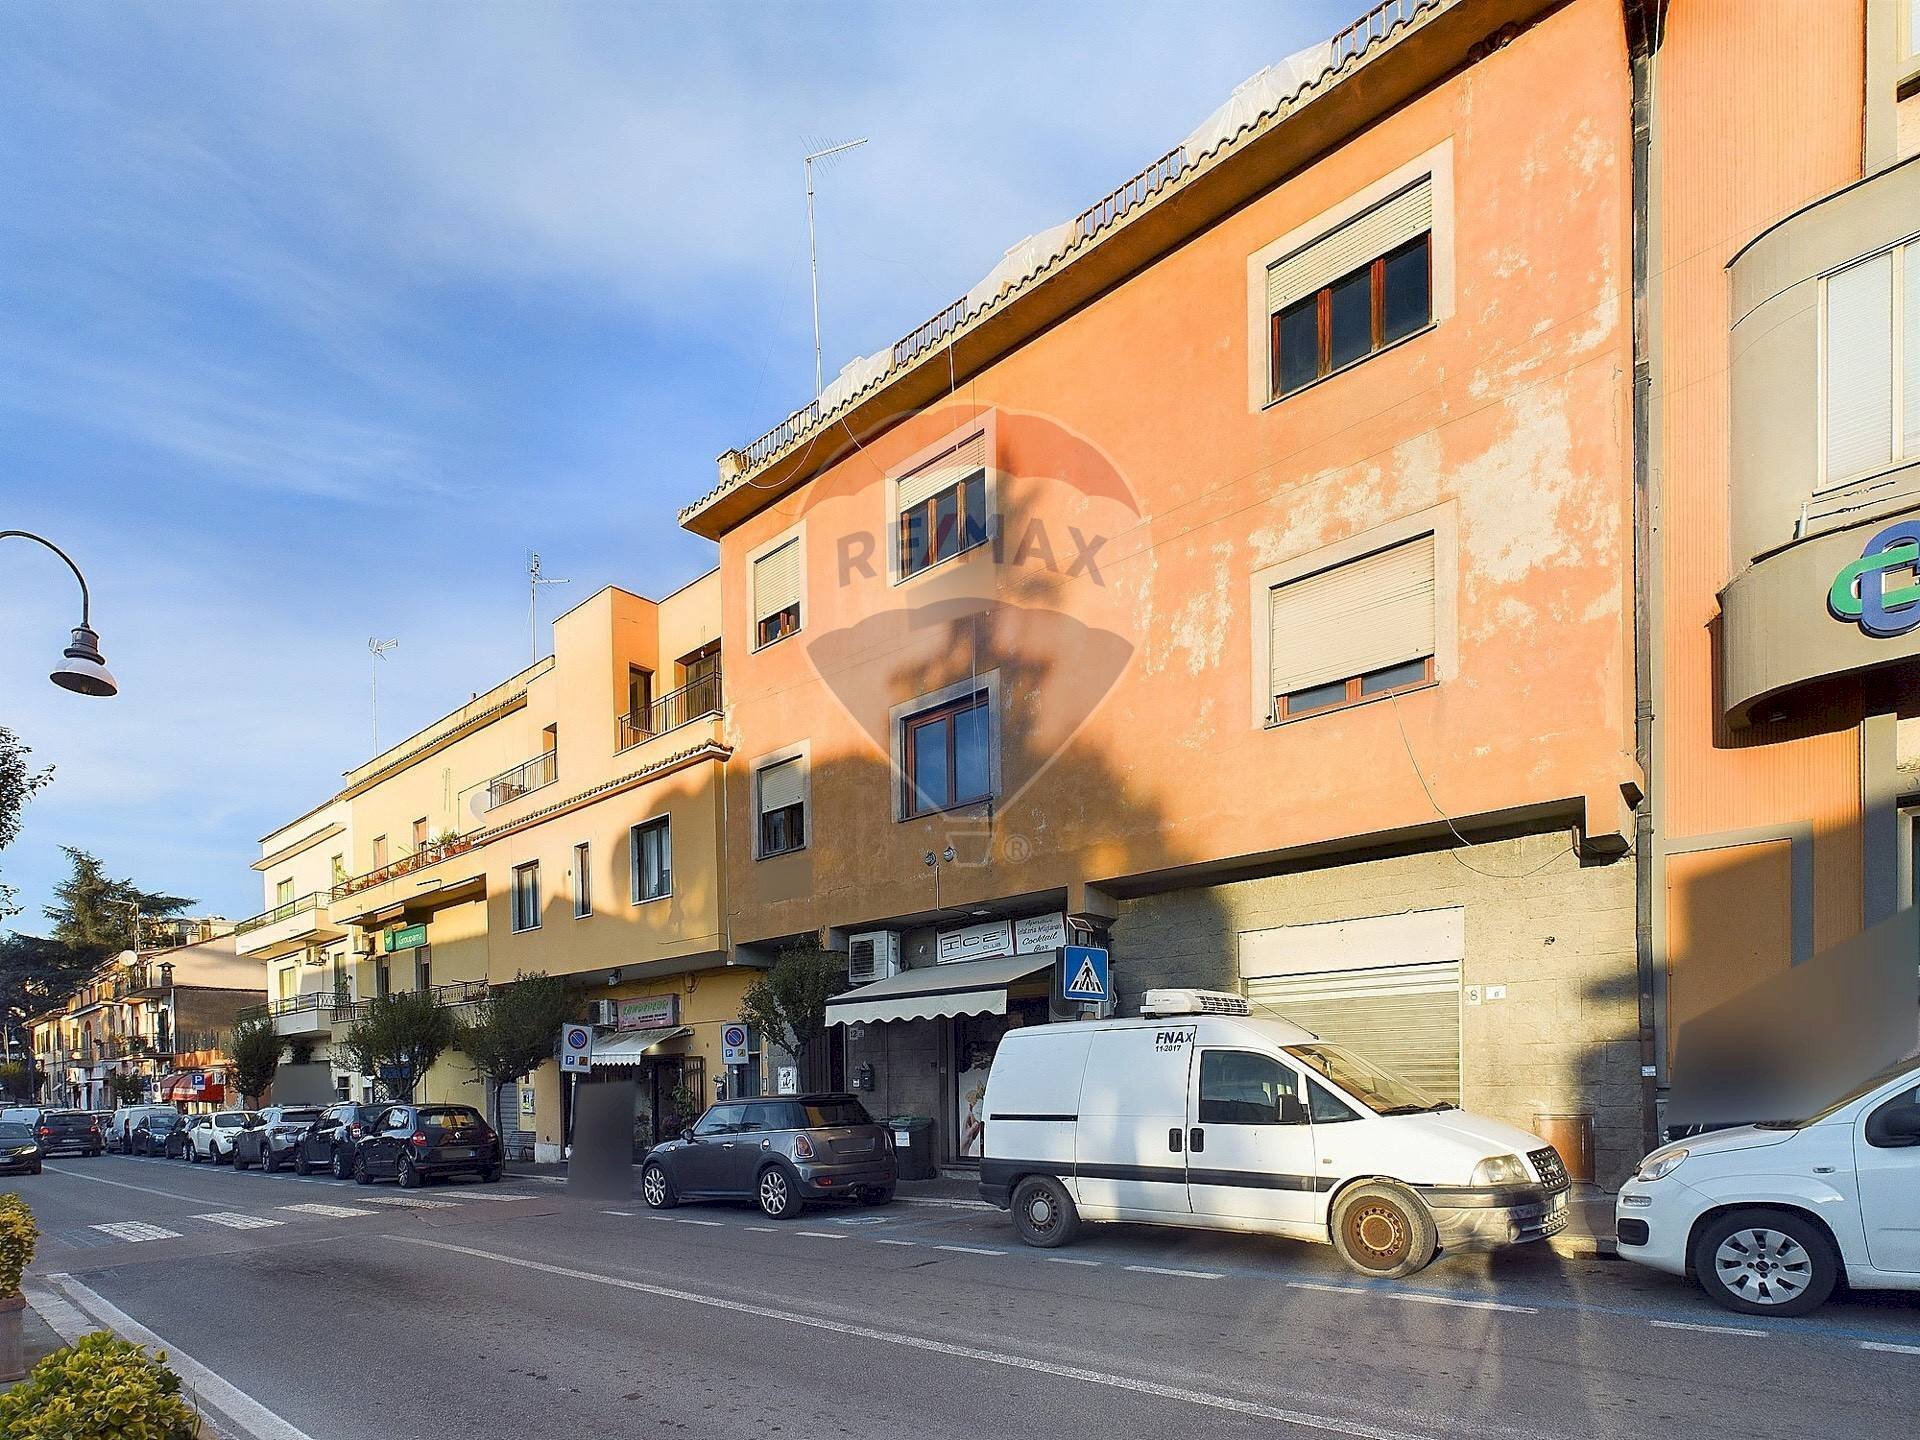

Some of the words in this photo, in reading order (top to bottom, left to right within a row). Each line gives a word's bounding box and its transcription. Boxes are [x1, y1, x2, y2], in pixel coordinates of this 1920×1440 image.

[1022, 931, 1058, 945] Cocktail
[982, 942, 1001, 950] CLUB
[1033, 944, 1049, 952] Bar
[566, 1056, 574, 1065] P
[195, 1075, 202, 1083] P
